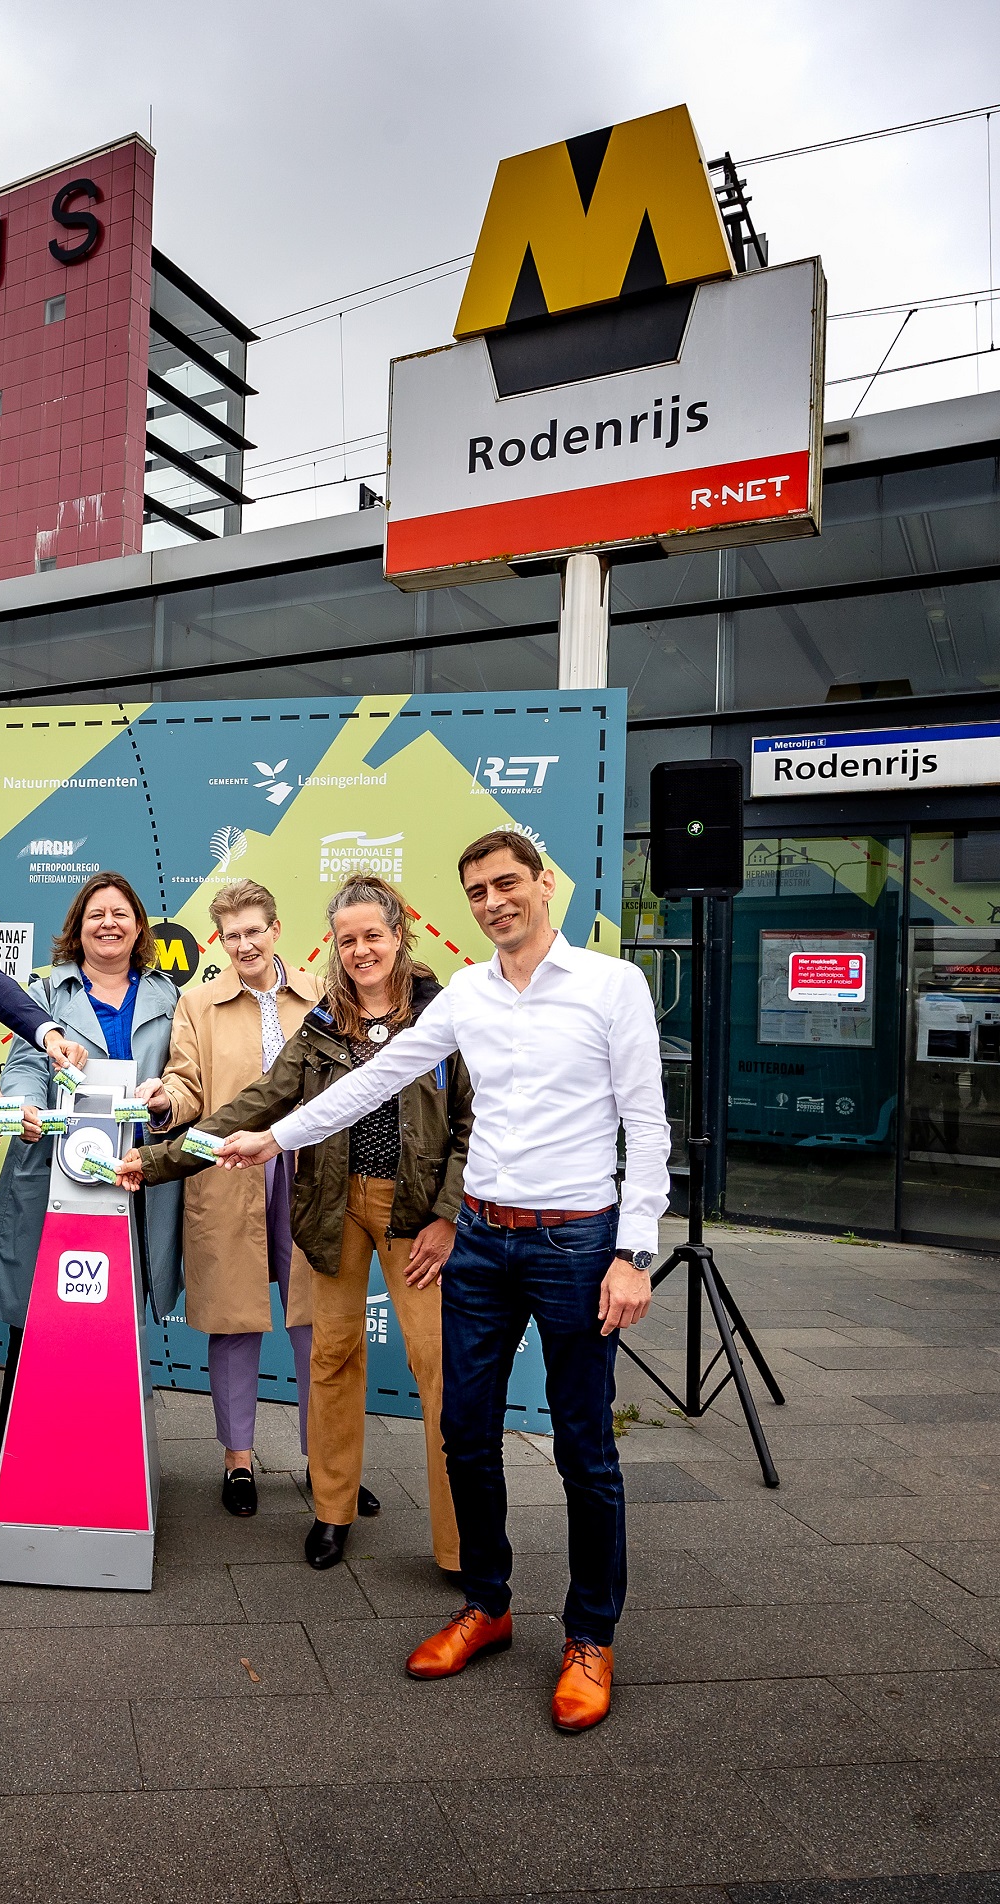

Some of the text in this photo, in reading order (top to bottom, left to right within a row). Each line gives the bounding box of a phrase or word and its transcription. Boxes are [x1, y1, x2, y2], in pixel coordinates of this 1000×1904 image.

[453, 103, 733, 340] M
[467, 394, 710, 475] Rodenrijs
[774, 739, 816, 750] Metrolijn
[472, 756, 560, 787] RET
[774, 749, 938, 781] Rodenrijs
[3, 776, 138, 789] Natuurmonumenten
[208, 772, 387, 789] GEMEENTE Lansingerland
[469, 787, 543, 795] AARDIG ONDERWEG
[30, 840, 74, 856] MRDH
[331, 848, 393, 857] NATIONALE
[29, 863, 100, 872] METROPOOLREGIO
[320, 858, 403, 873] POSTCODE
[29, 874, 66, 884] ROTTERDAM
[67, 874, 81, 883] DEN
[746, 869, 811, 879] HERENBERDERIJ
[757, 878, 811, 887] VLINERSTRIK
[622, 901, 658, 910] LKSCHUUR
[5, 945, 19, 960] ZO
[738, 1060, 805, 1076] ROTTERDAM
[65, 1259, 103, 1280] OV
[65, 1282, 93, 1296] pay
